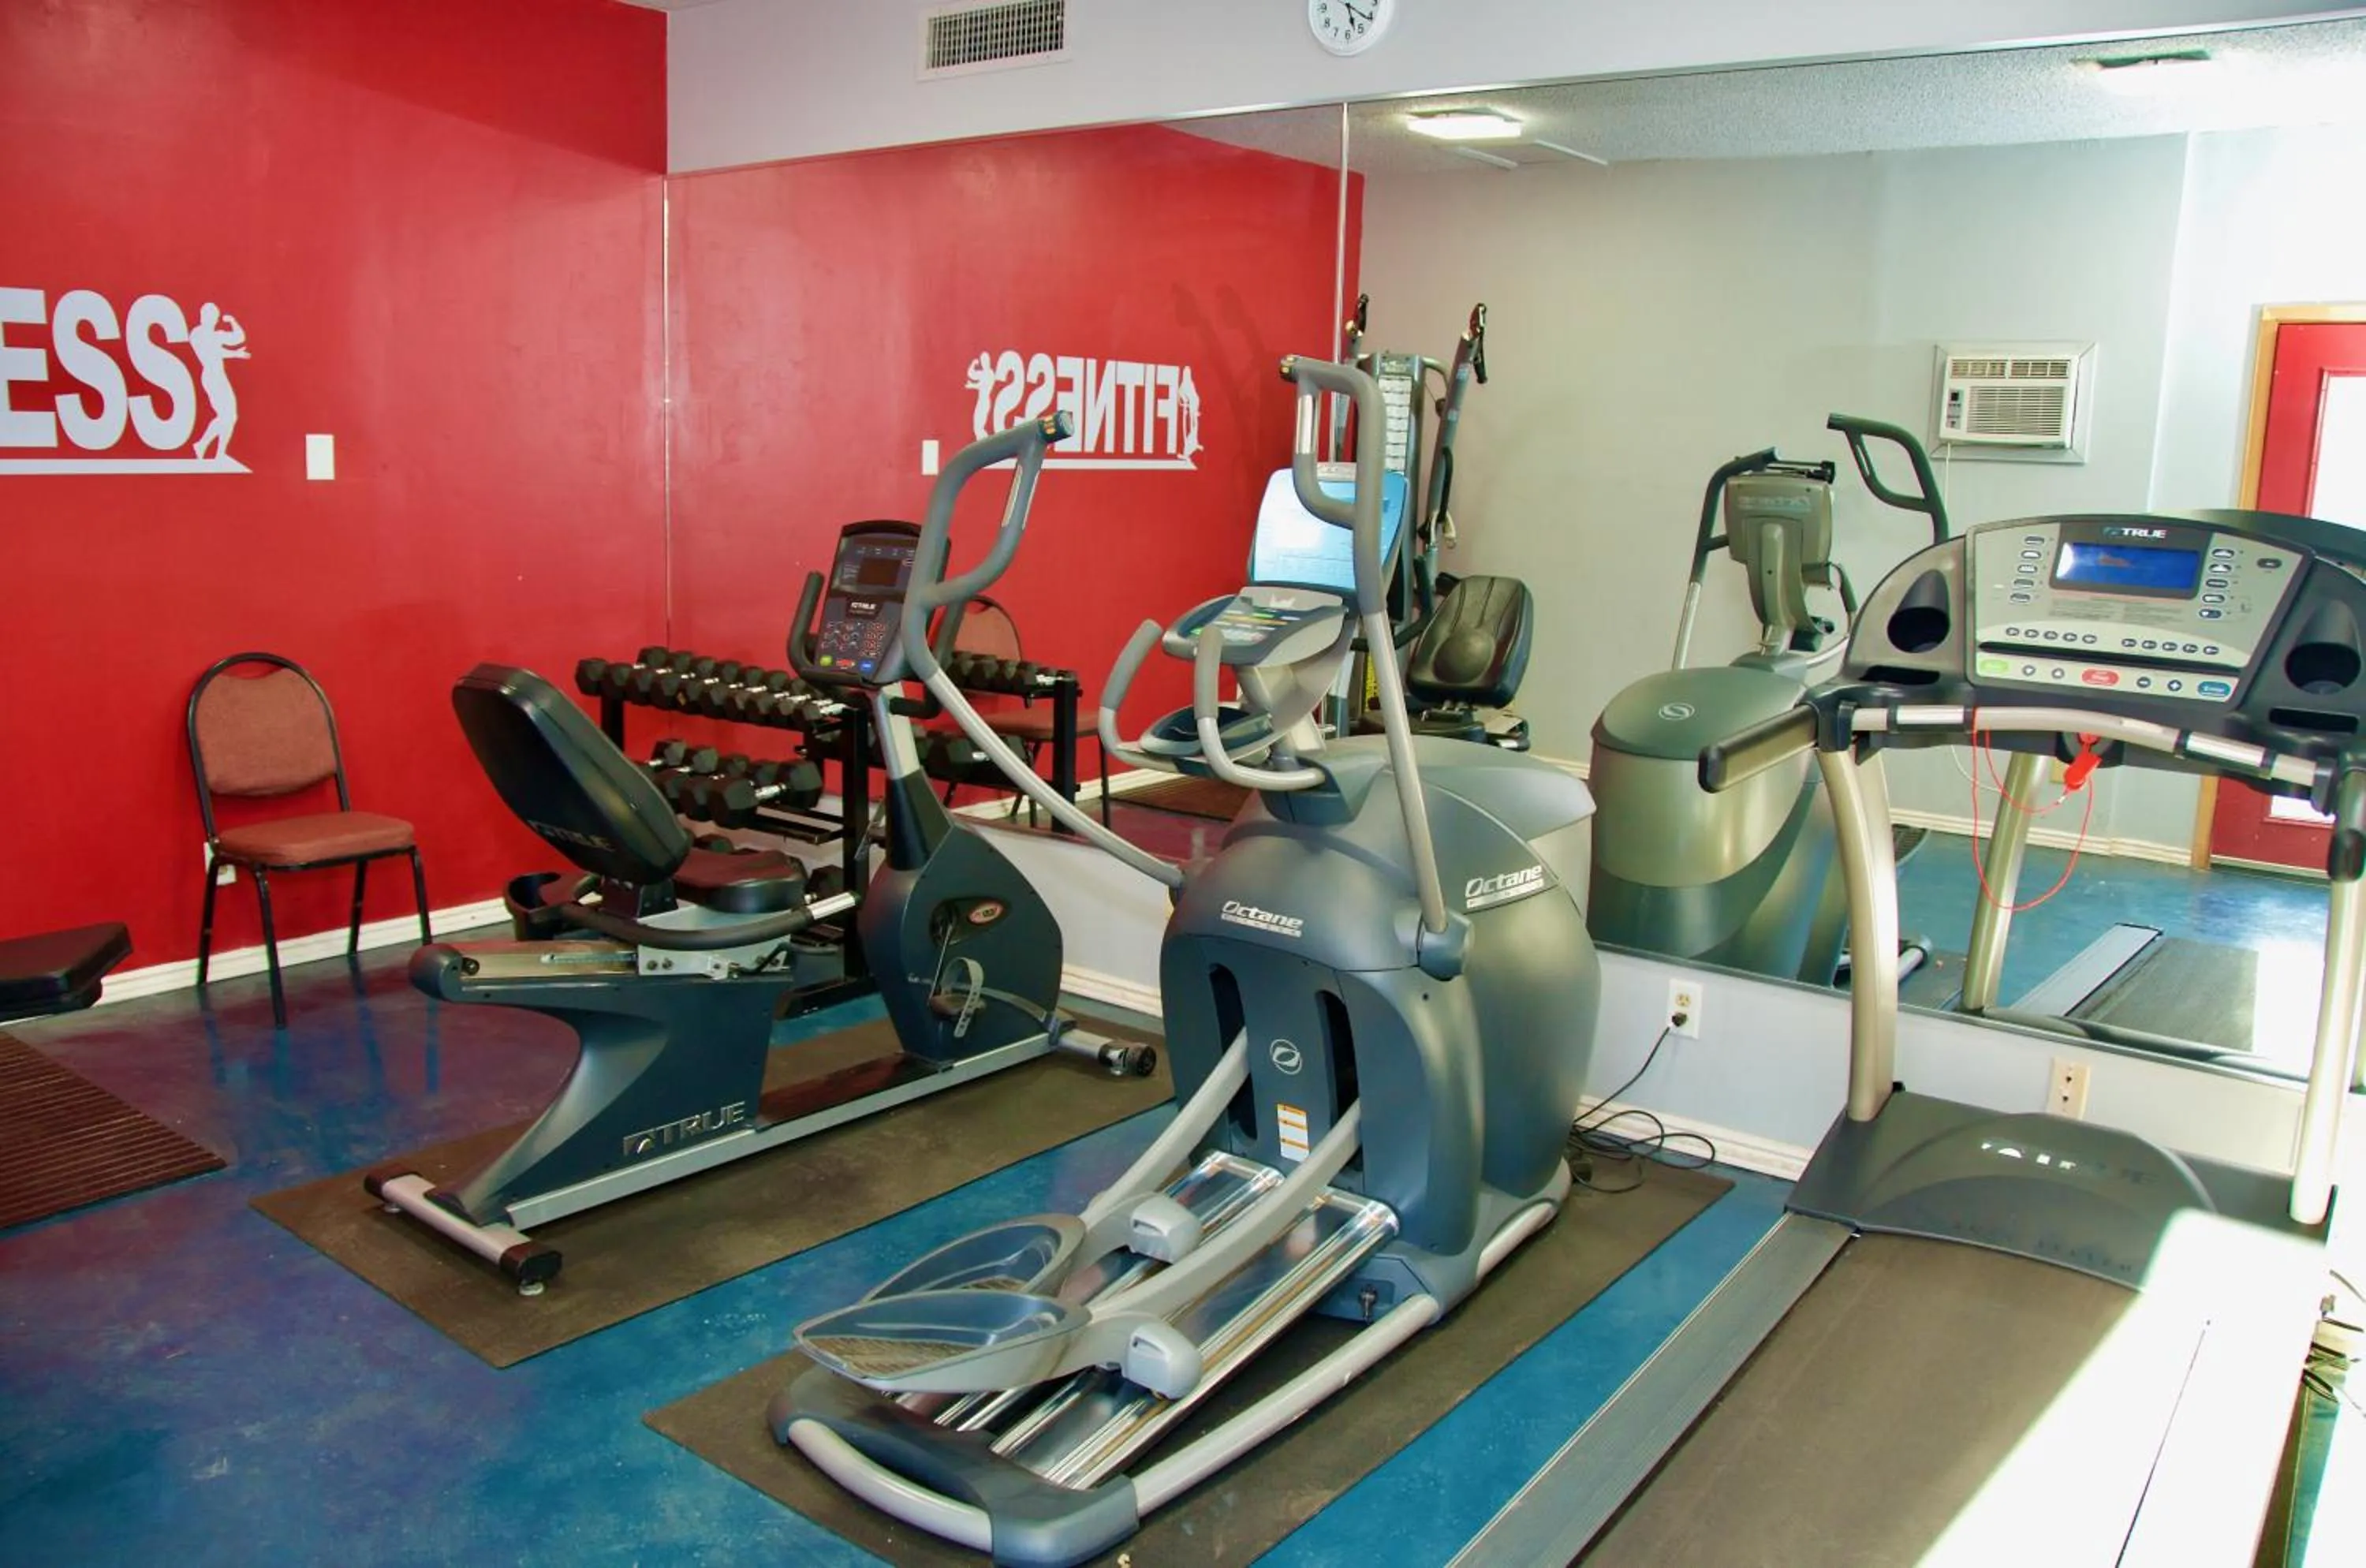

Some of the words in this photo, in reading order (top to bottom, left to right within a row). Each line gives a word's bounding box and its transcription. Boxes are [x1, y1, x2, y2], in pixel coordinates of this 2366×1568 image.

[1345, 29, 1351, 39] 6
[2122, 528, 2166, 539] TRUE
[1465, 865, 1543, 898] Octane
[1222, 901, 1304, 929] Octane
[655, 1101, 745, 1144] TRUE
